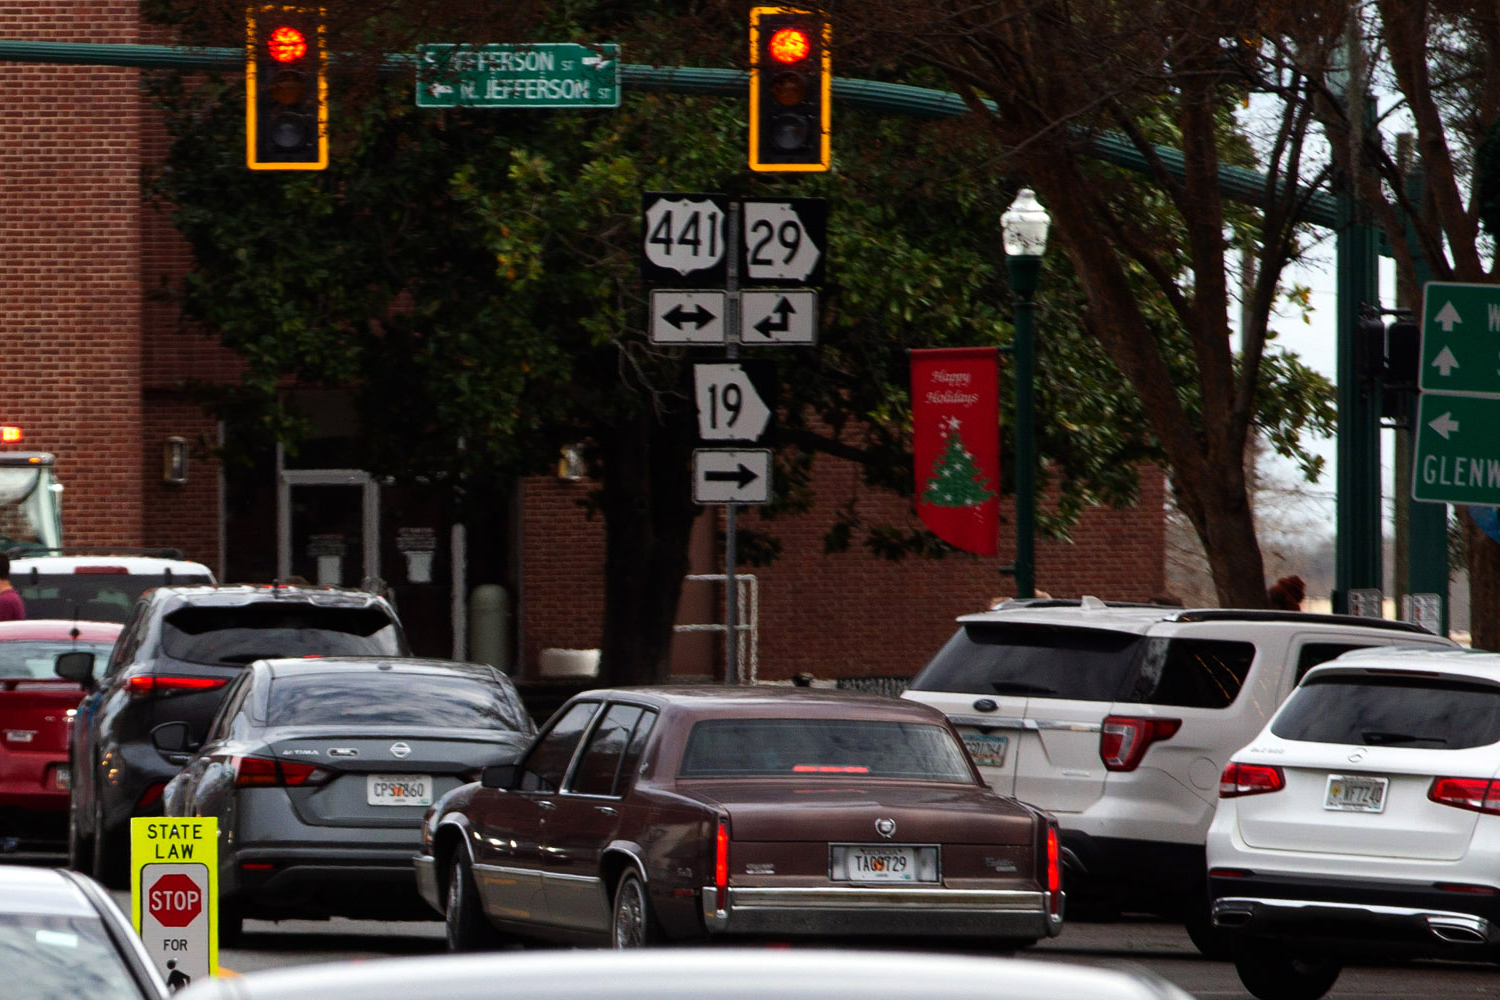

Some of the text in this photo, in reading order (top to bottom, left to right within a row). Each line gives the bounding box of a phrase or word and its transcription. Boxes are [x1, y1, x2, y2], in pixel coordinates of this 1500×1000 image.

[483, 79, 591, 100] JEFFERSON
[649, 210, 717, 258] 441
[750, 219, 801, 267] 29
[707, 382, 742, 430] 19
[147, 824, 203, 840] STATE
[155, 844, 194, 859] LAW
[151, 890, 199, 911] STOP
[163, 939, 188, 951] FOR
